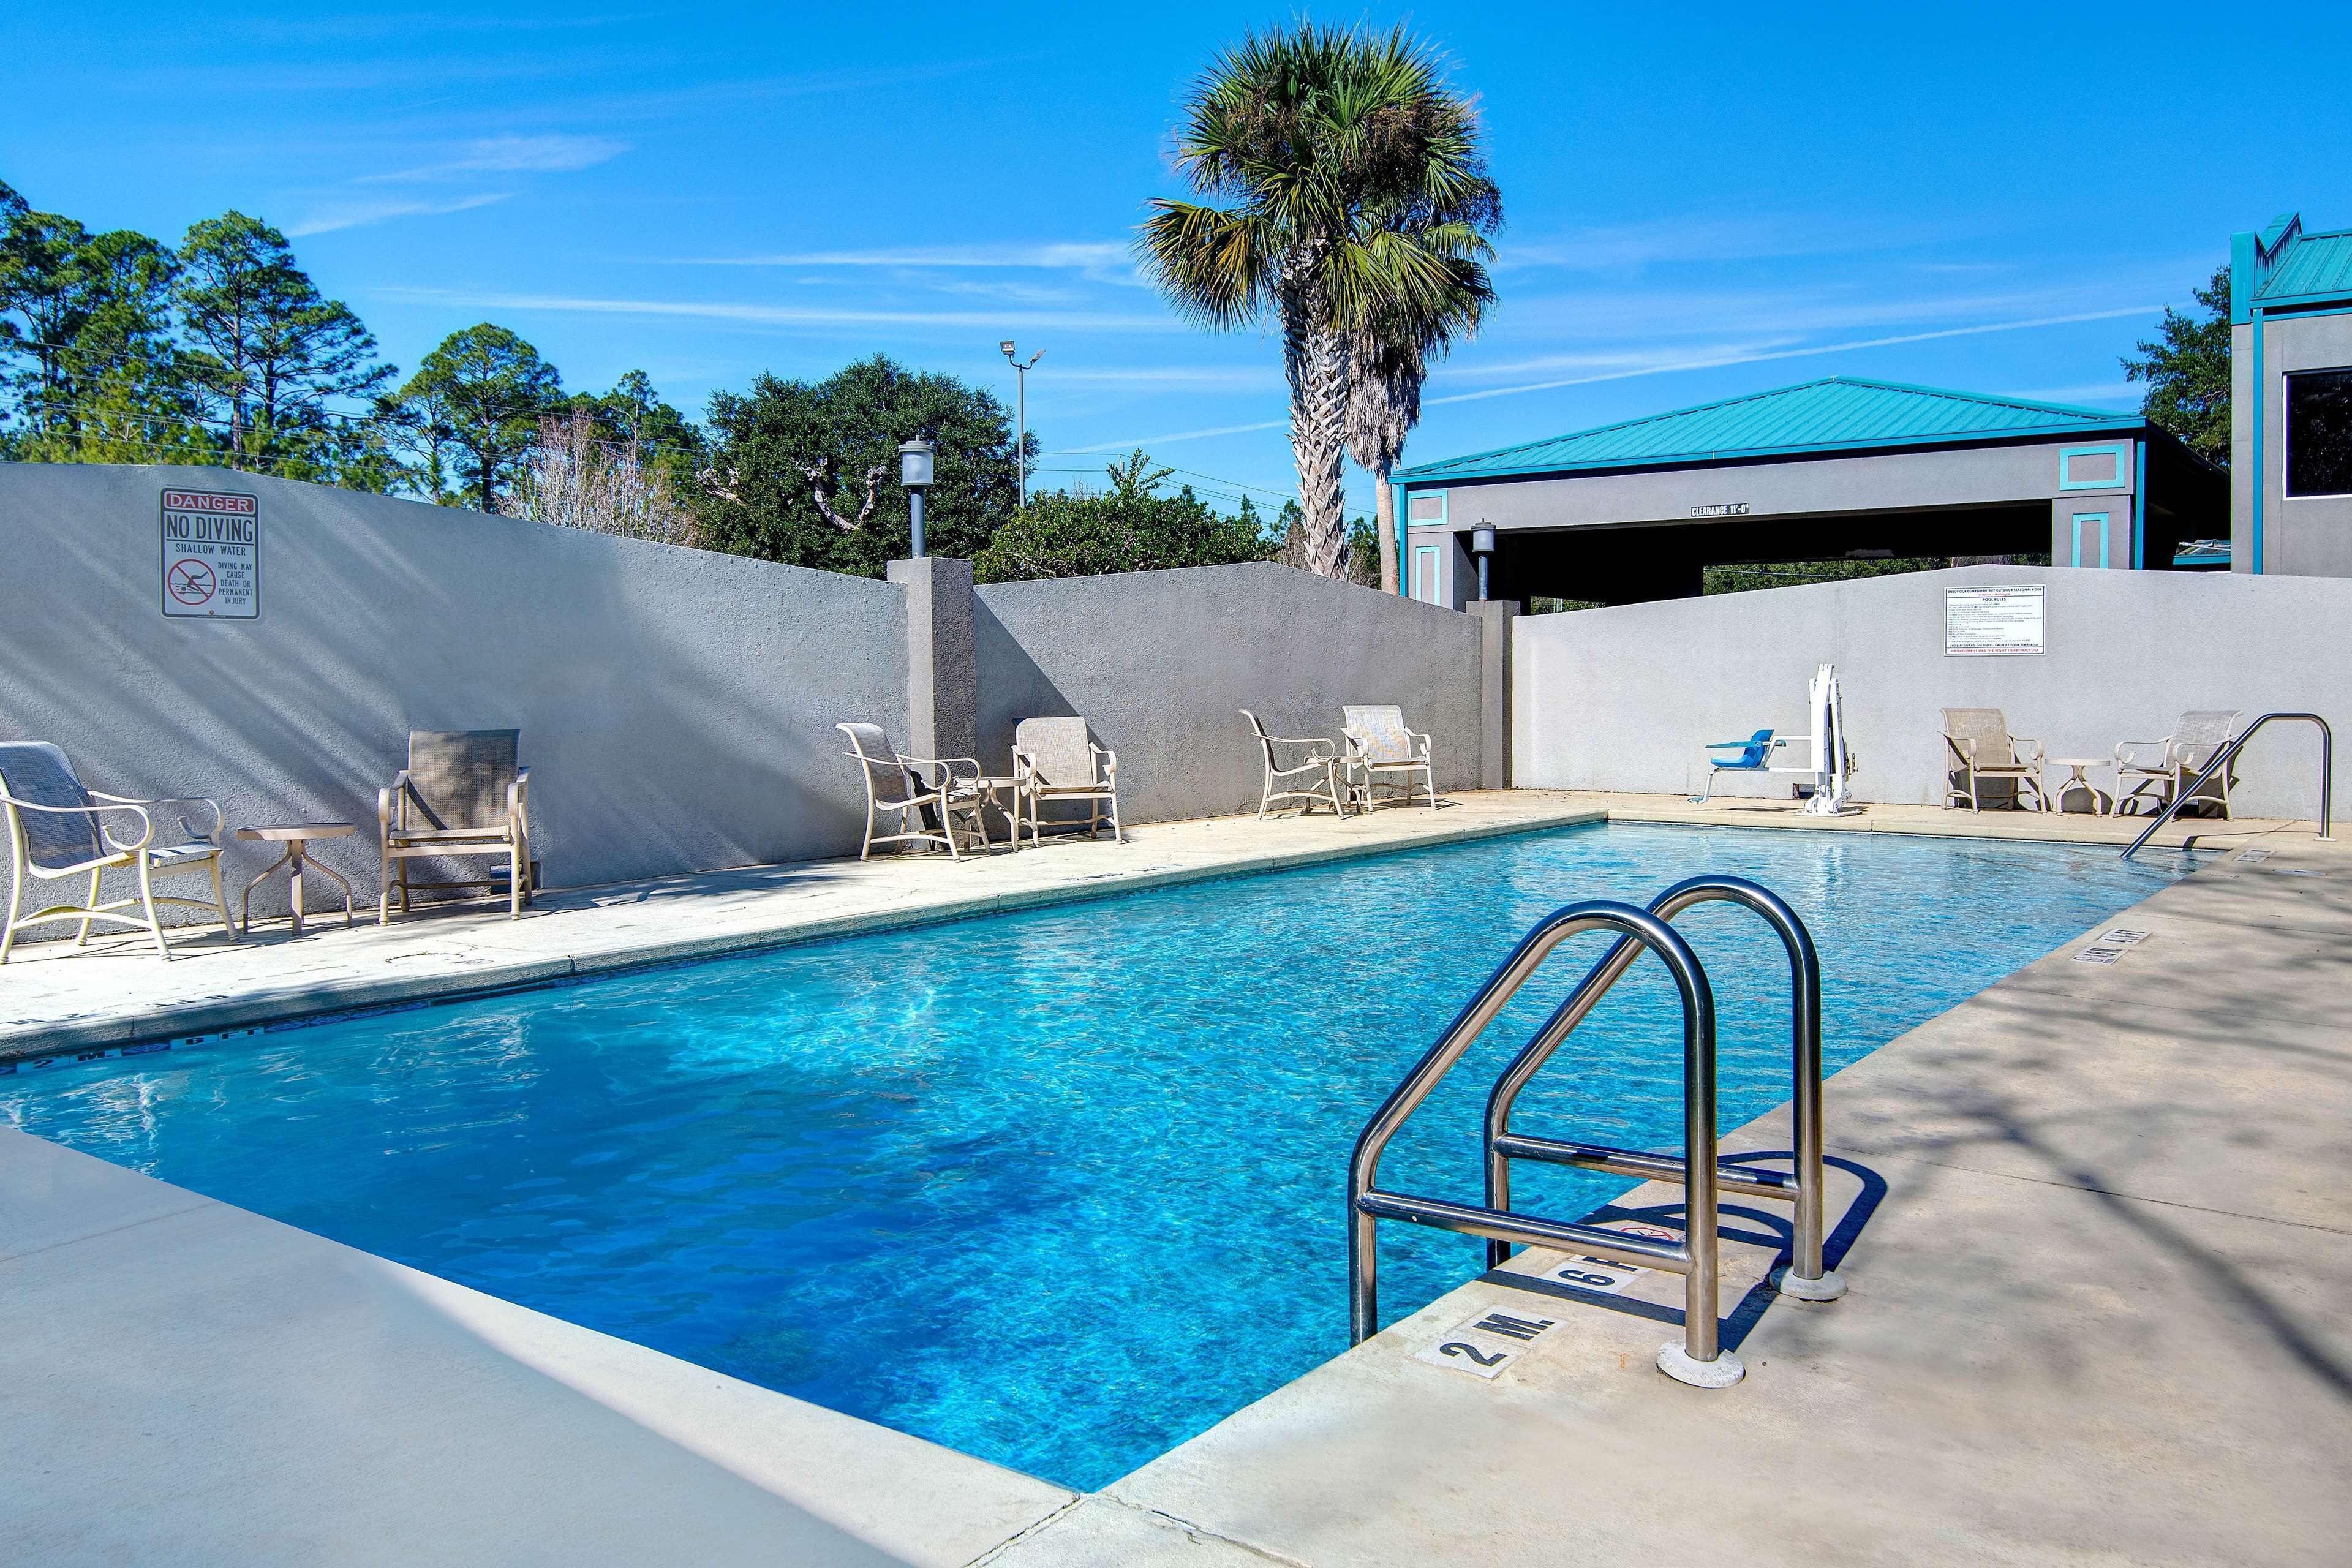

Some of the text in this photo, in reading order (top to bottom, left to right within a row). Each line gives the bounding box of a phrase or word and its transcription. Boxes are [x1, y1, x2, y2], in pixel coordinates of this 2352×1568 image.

[170, 494, 249, 511] DANGER
[1692, 505, 1727, 516] CLEARANCE
[167, 514, 254, 542] NO DIVING
[176, 543, 246, 556] SHALLOW WATER
[1558, 1269, 1615, 1286] 6
[1439, 1313, 1555, 1367] 2 M.
